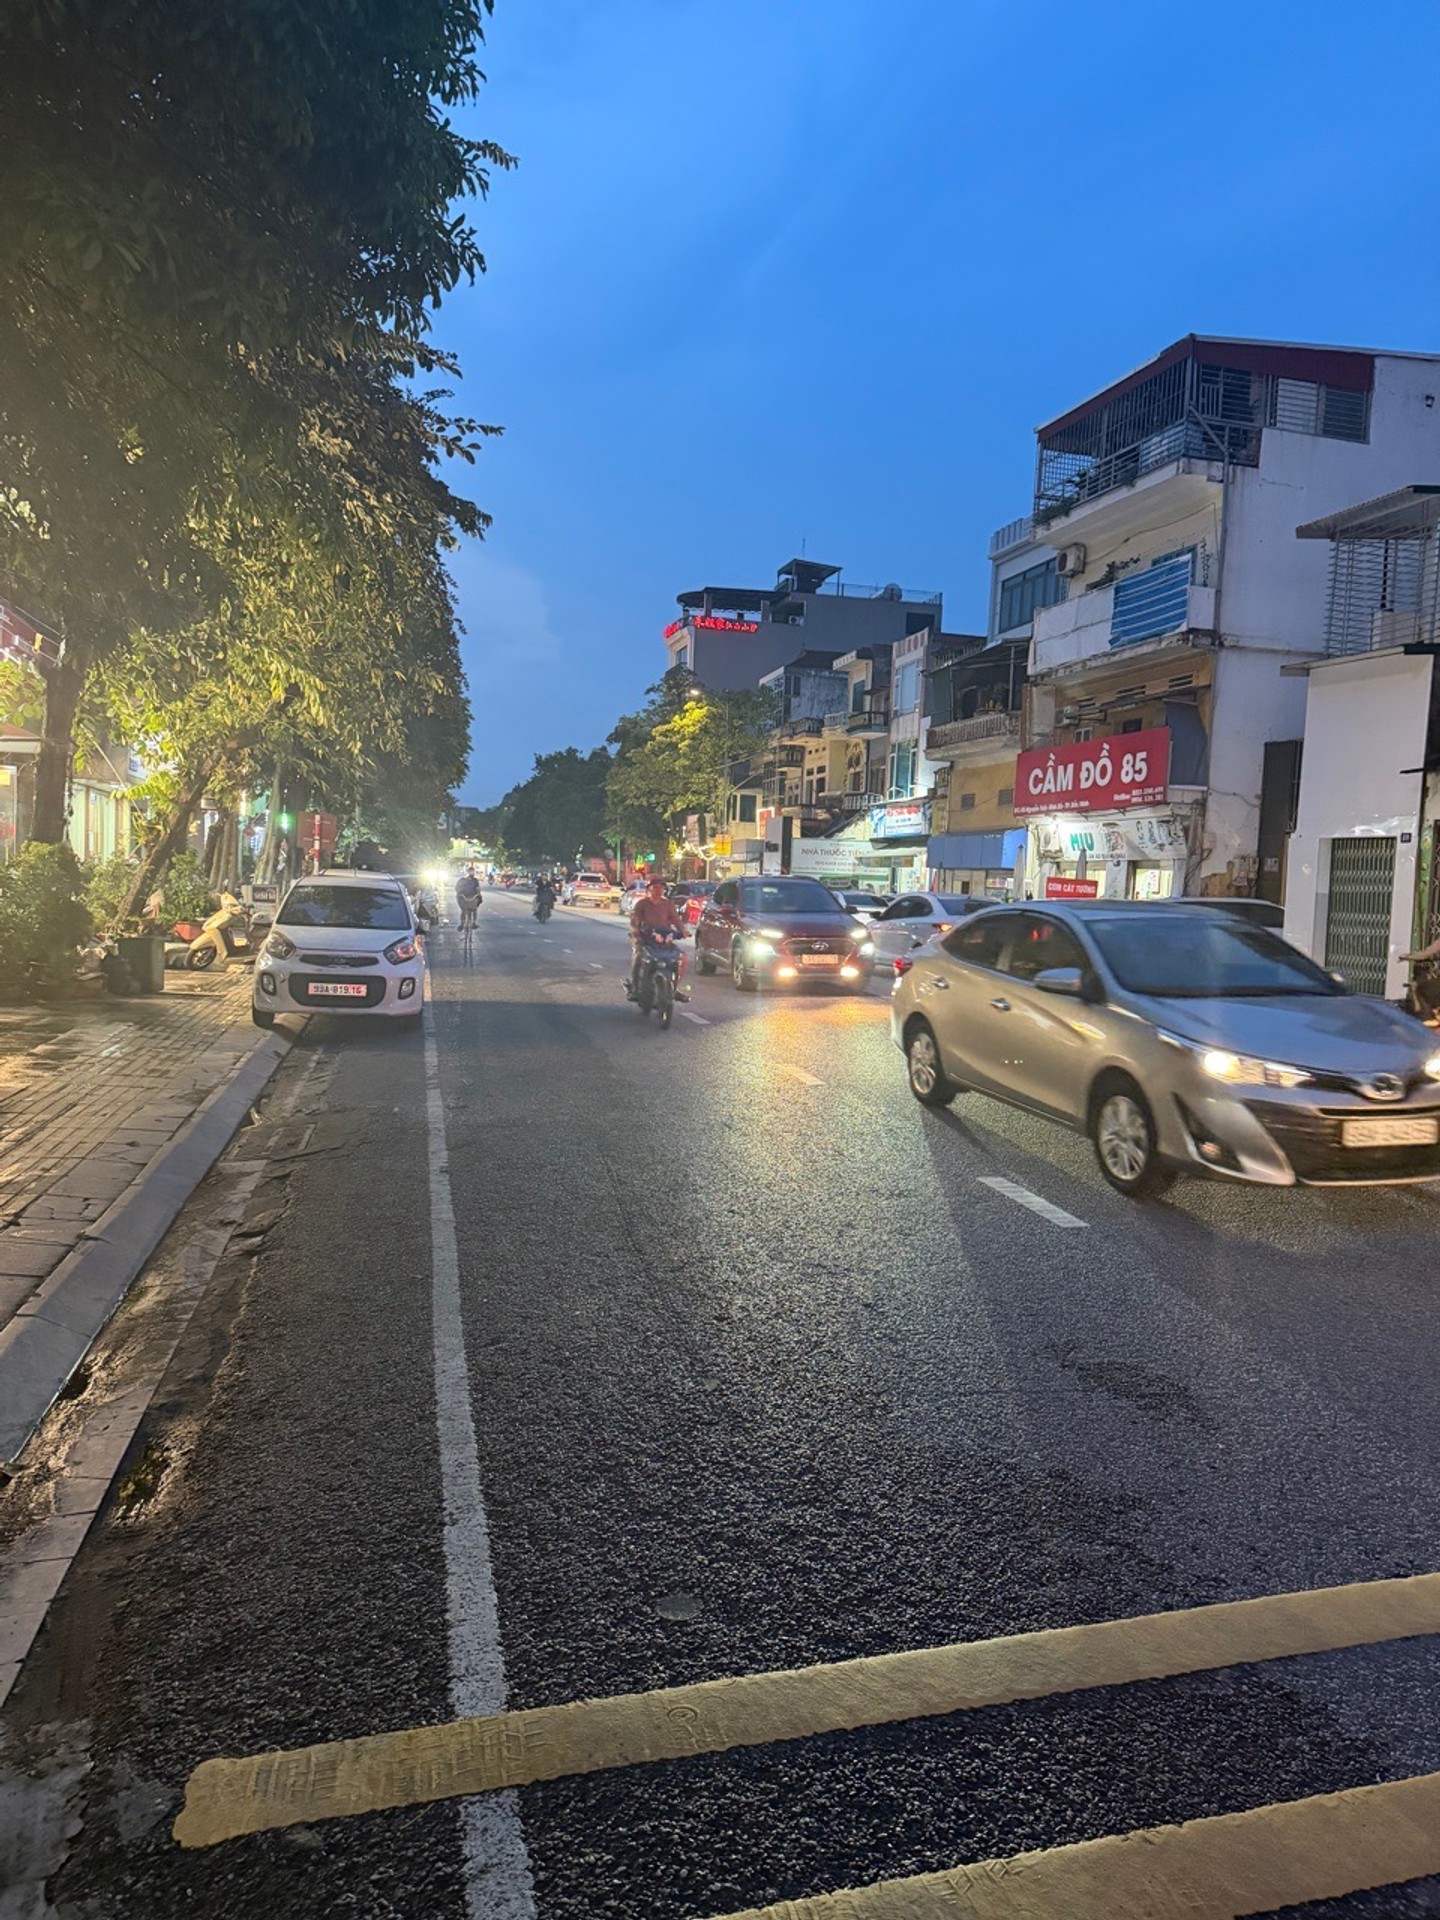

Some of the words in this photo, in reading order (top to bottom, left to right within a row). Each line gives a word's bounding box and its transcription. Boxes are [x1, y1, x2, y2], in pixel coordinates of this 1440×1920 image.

[1029, 752, 1074, 795] CẦM
[1080, 742, 1113, 789] ĐỒ
[1121, 751, 1148, 784] 85
